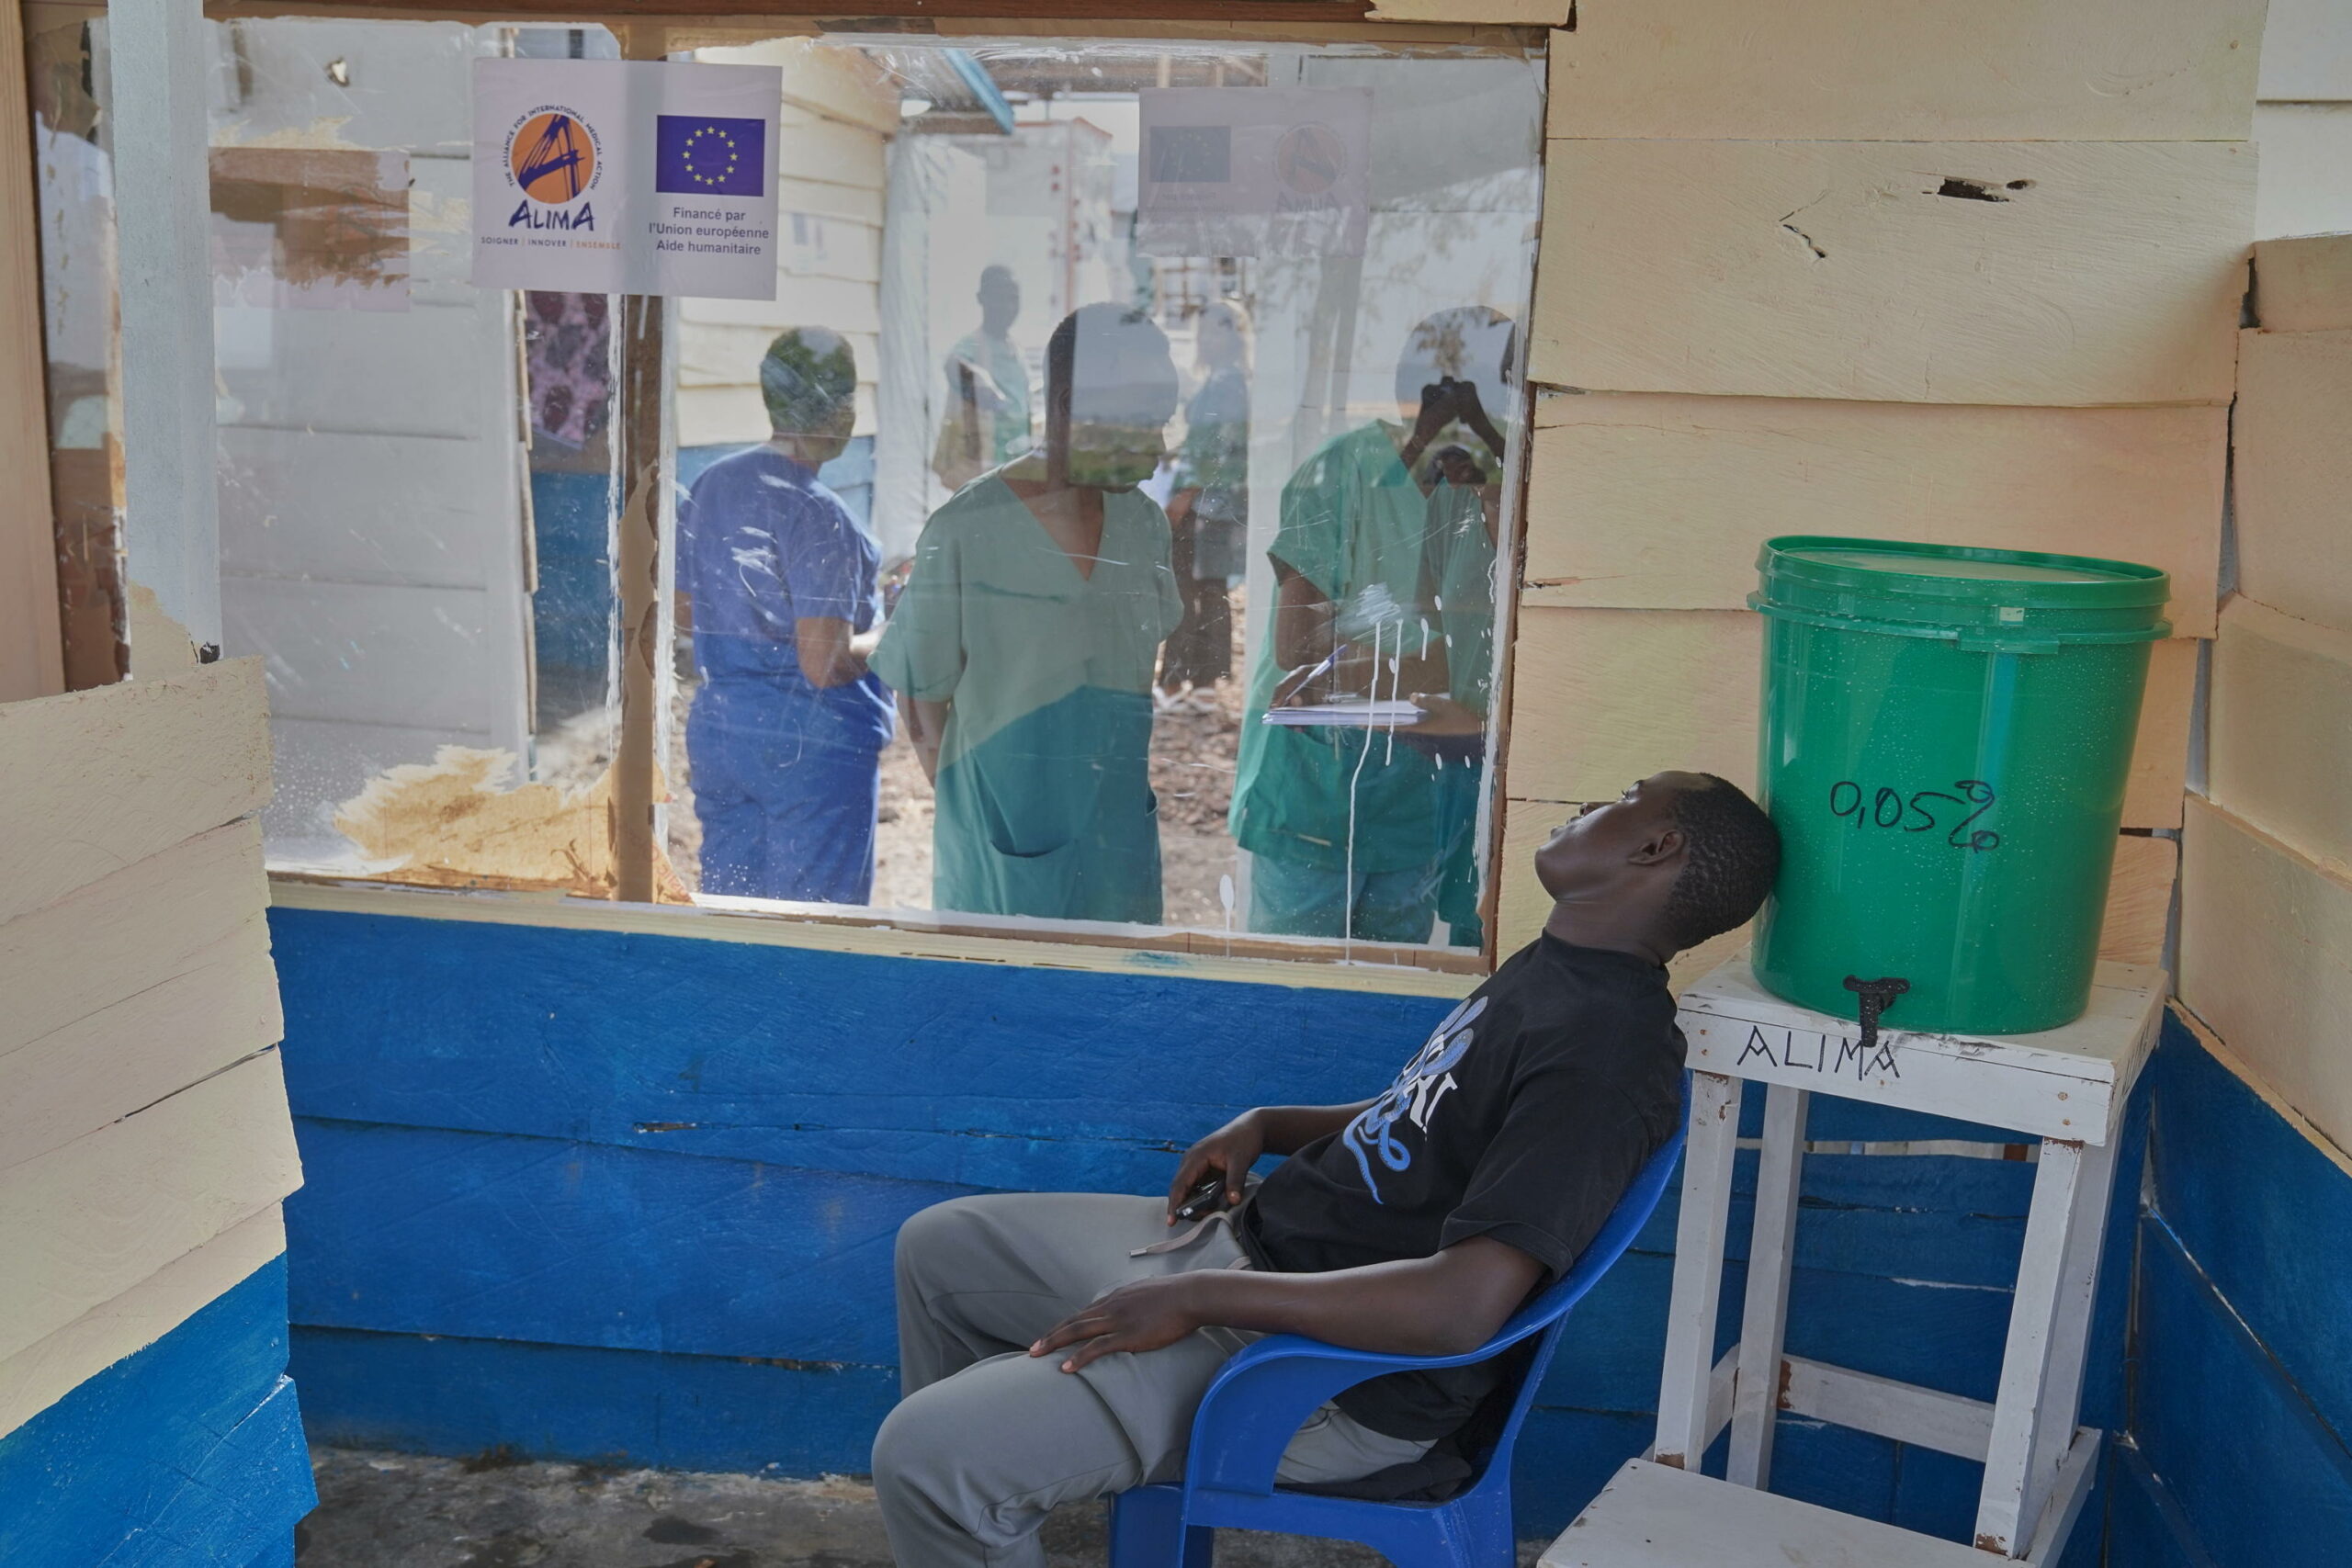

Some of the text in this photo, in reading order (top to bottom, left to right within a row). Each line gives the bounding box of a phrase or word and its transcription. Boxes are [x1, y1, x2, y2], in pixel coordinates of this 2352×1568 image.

[514, 115, 526, 129] FOR
[528, 105, 584, 122] INTERNATIONAL
[503, 130, 514, 167] ALLIANCE
[585, 123, 603, 155] MEDICAL
[590, 161, 603, 190] ACTION
[508, 198, 595, 231] ALIMA
[673, 207, 746, 221] Financé par
[649, 222, 769, 239] l'Union européenne
[481, 236, 621, 250] SOIGNER INNOVER ENSEMBLE
[656, 240, 761, 254] Aide humanitaire
[1830, 780, 2000, 853] 0,05%
[1736, 1025, 1901, 1081] ALIMA
